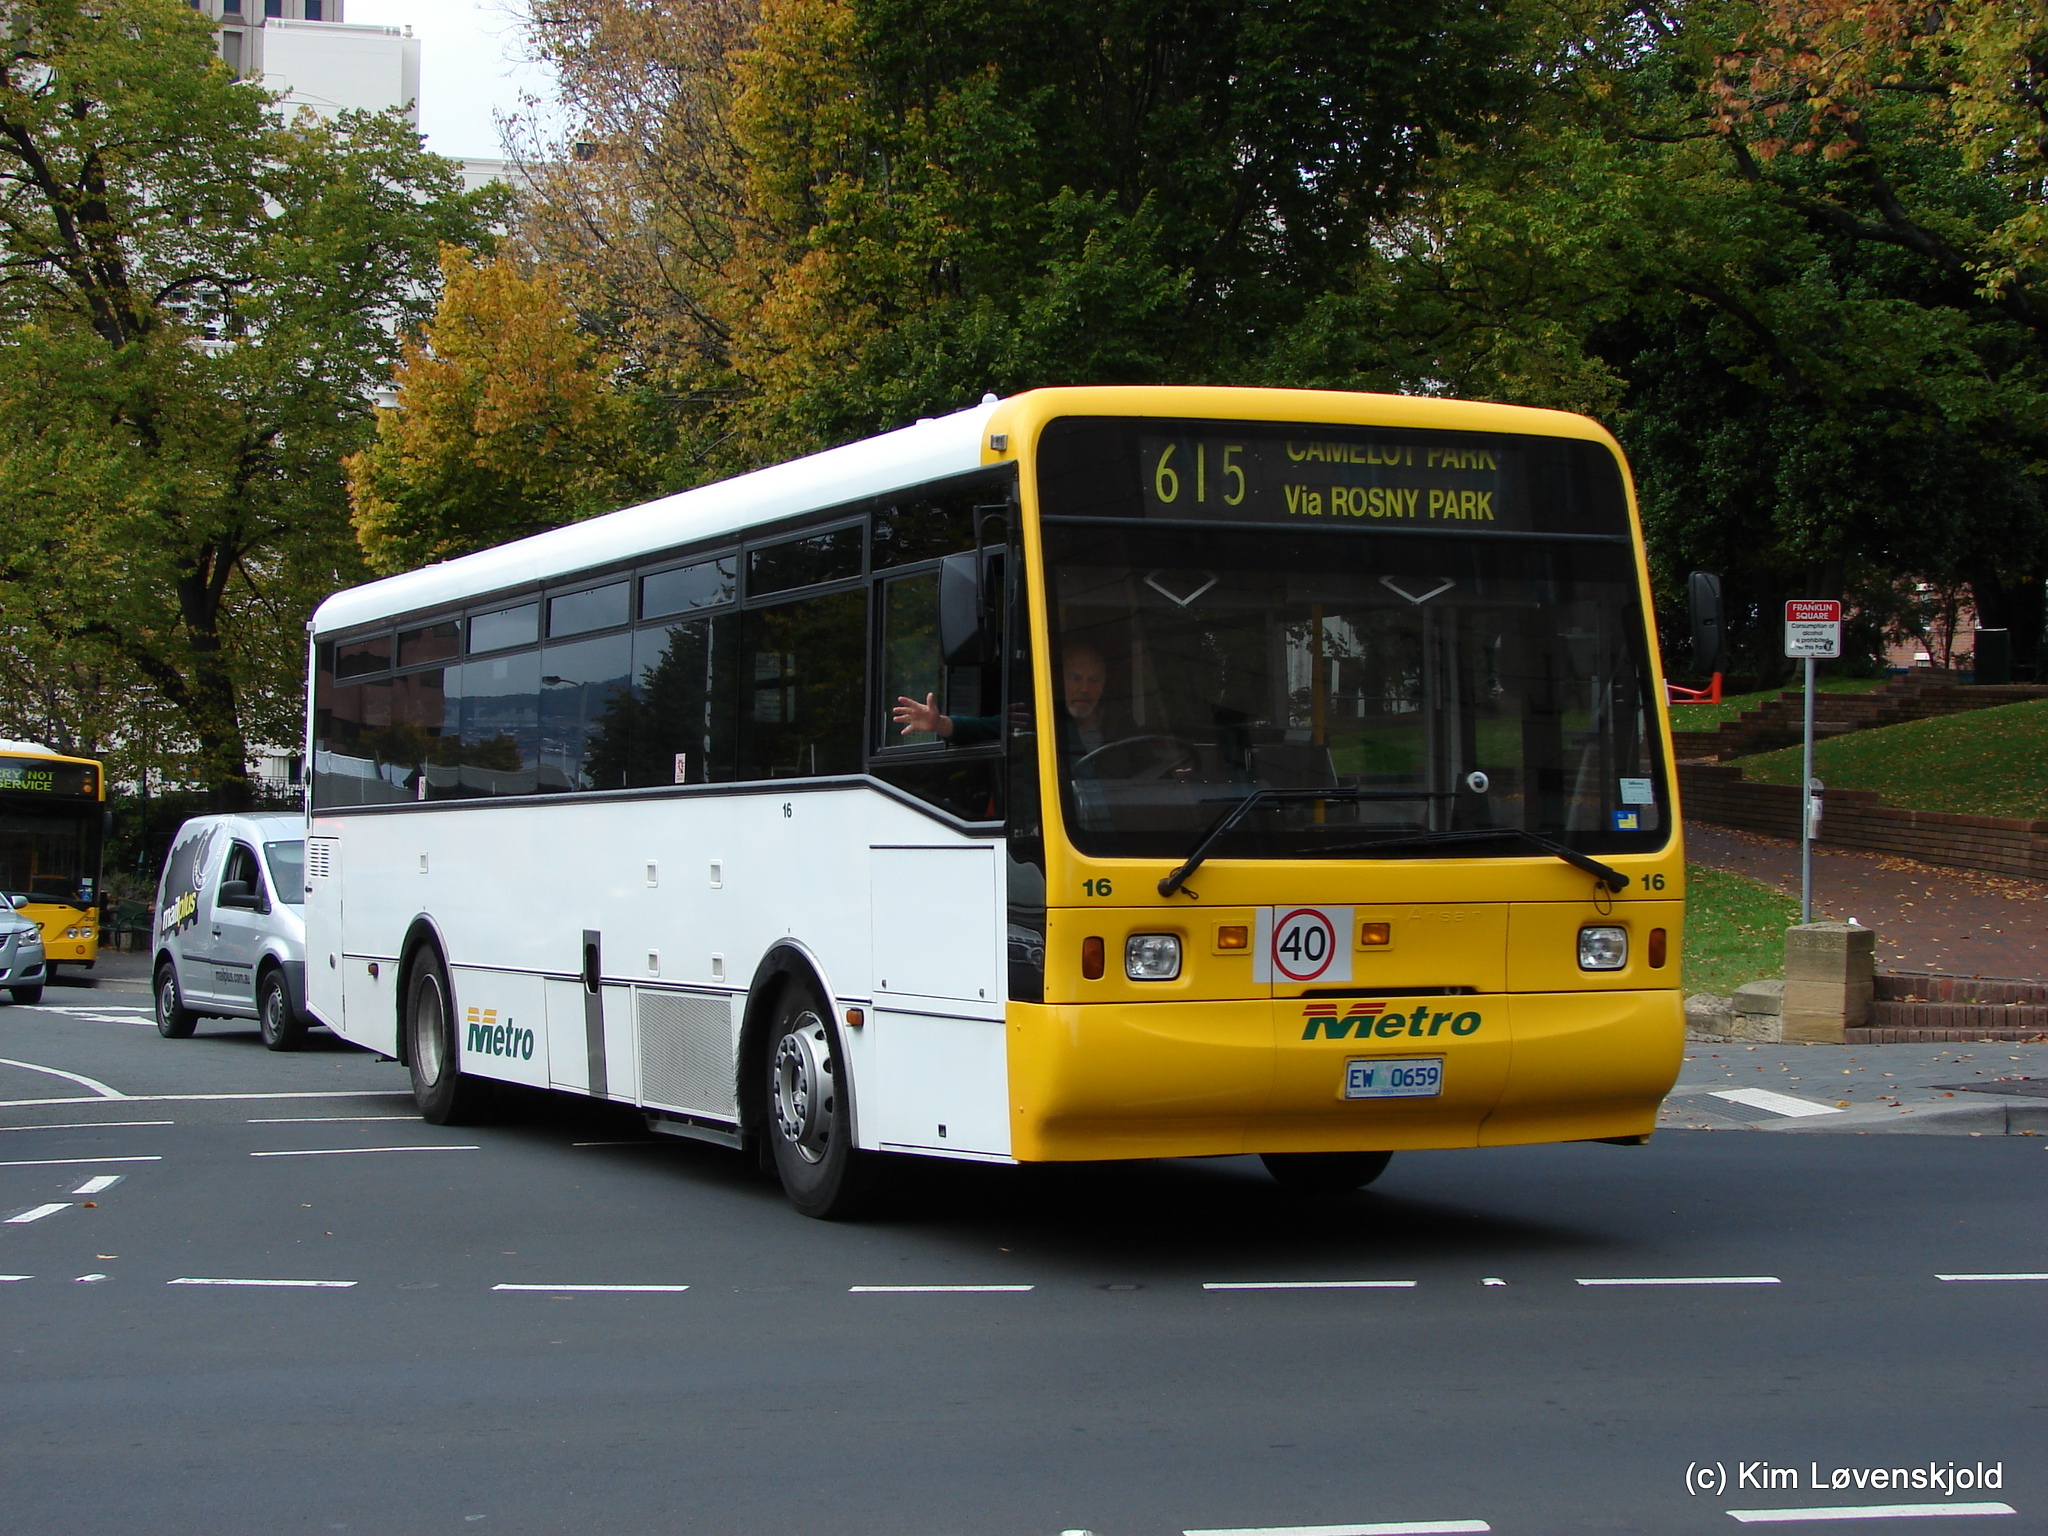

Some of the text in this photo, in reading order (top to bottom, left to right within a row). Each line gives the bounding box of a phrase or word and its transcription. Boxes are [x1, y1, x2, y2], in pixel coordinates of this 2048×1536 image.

[1286, 441, 1497, 471] CAMELOT PARK
[1155, 443, 1246, 506] 615
[1283, 483, 1495, 521] Via ROSNY PARK
[0, 768, 54, 781] RY NOT
[783, 802, 792, 819] 16
[1082, 877, 1112, 897] 16
[1641, 873, 1665, 892] 16
[162, 891, 197, 931] mailplus
[1279, 925, 1326, 962] 40
[466, 1006, 534, 1061] Metro
[1301, 1002, 1482, 1041] Metro
[1350, 1066, 1439, 1089] EW 0659
